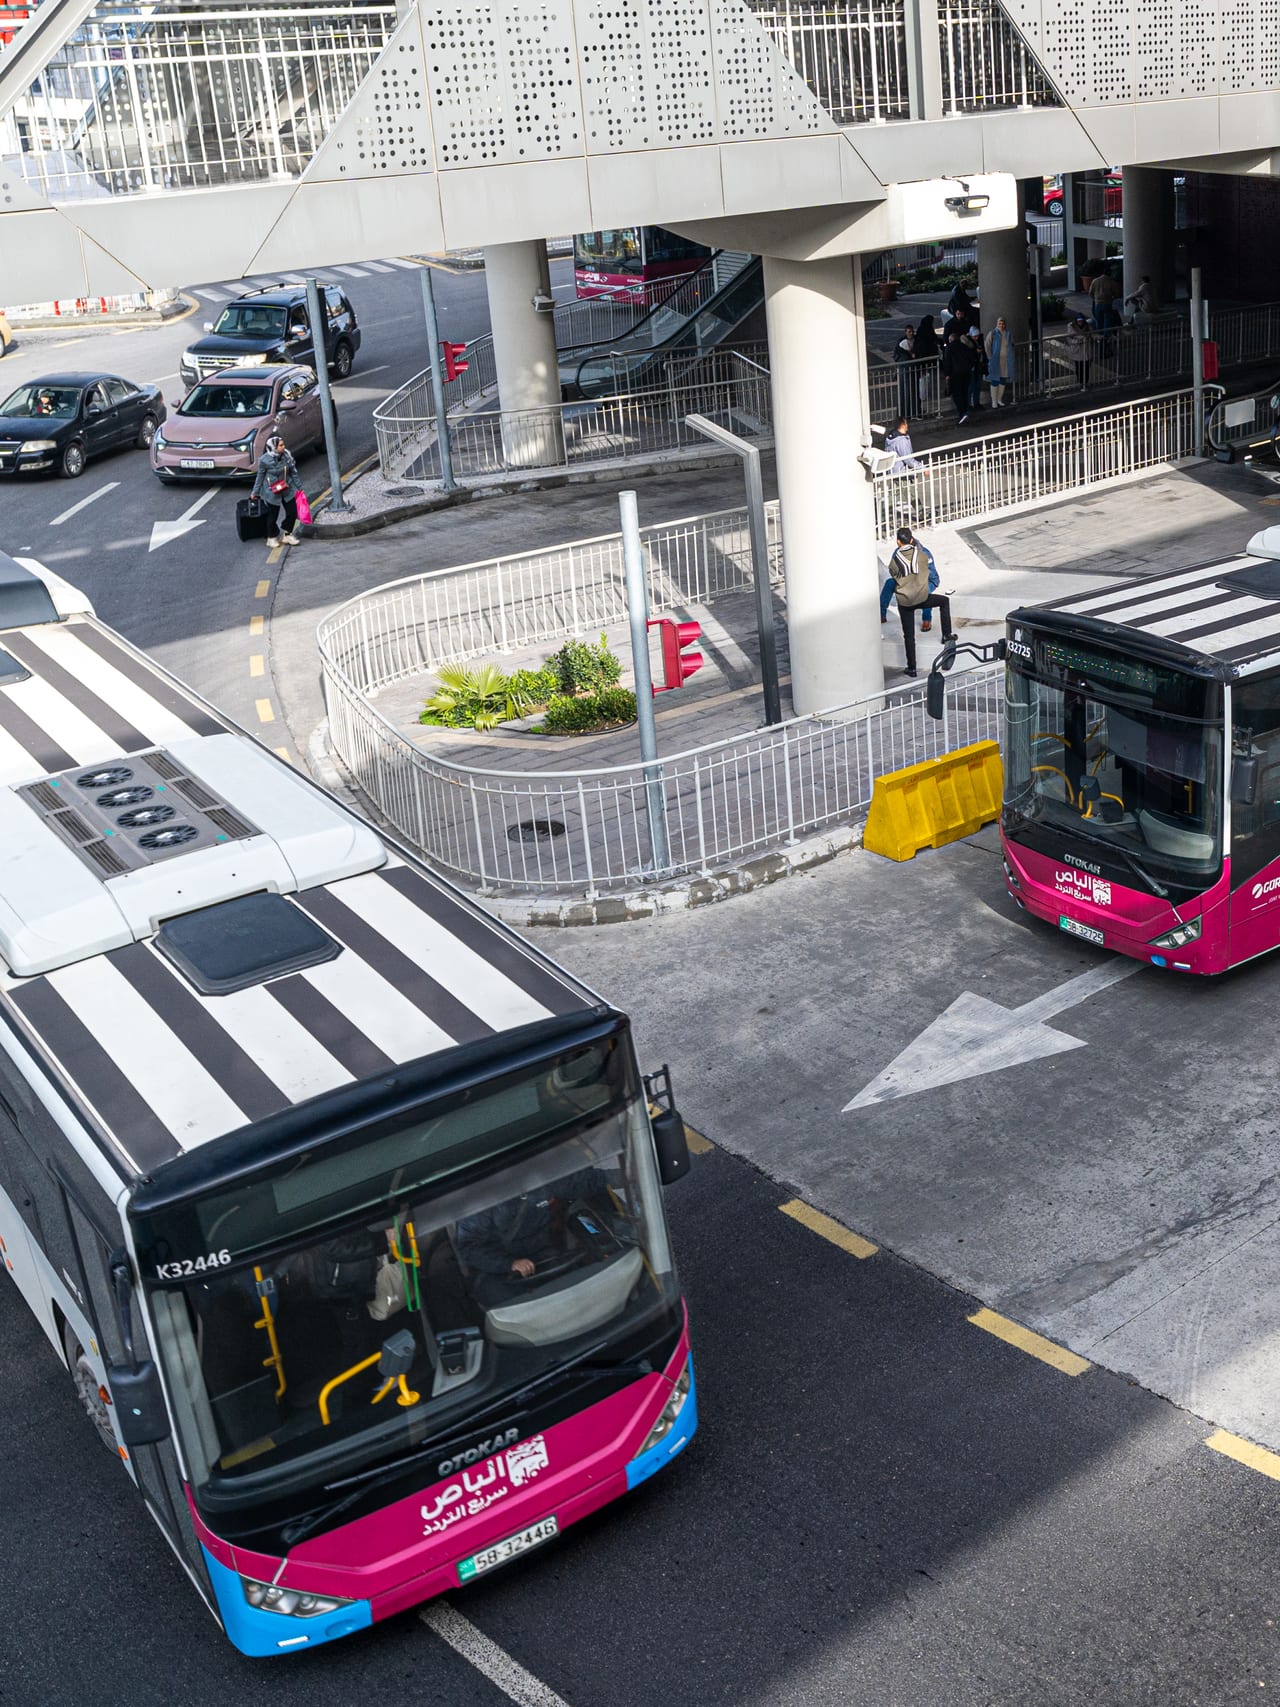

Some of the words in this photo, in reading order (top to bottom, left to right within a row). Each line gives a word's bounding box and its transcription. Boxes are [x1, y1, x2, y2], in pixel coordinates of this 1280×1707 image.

[1055, 870, 1092, 890] الباص
[1064, 854, 1101, 875] OTOKAR
[156, 1249, 232, 1280] K32446
[438, 1428, 519, 1477] OTOKAR
[420, 1456, 506, 1520] الباص
[467, 1485, 508, 1515] سريع
[422, 1504, 467, 1536] التردد
